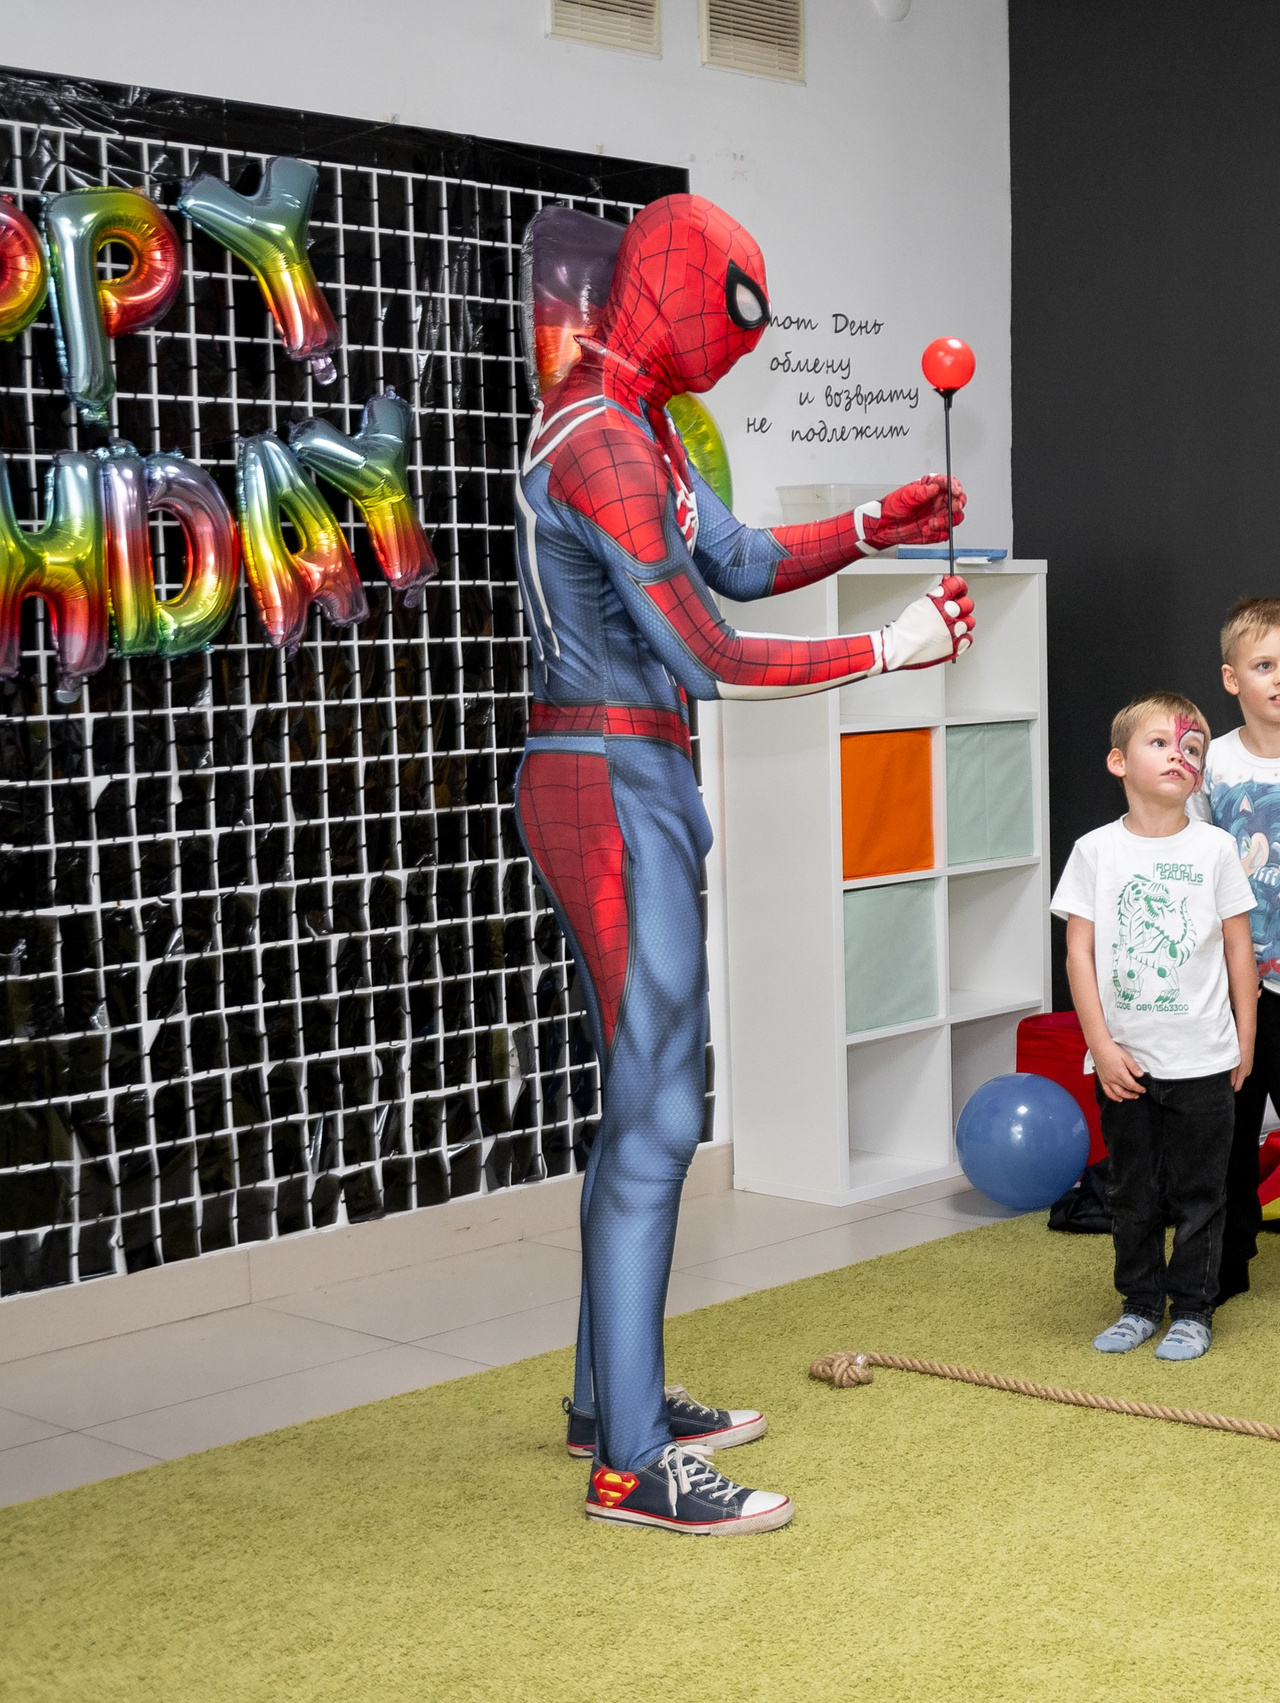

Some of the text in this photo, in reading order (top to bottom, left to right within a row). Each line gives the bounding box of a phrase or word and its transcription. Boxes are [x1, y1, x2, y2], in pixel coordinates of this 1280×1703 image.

[769, 313, 885, 336] тот День
[769, 351, 851, 379] обмену
[799, 384, 919, 413] и возврату
[746, 416, 911, 443] не подлежит
[1156, 863, 1194, 873] ROBOT
[1160, 871, 1204, 883] SAURUS
[1117, 1001, 1131, 1011] CODE
